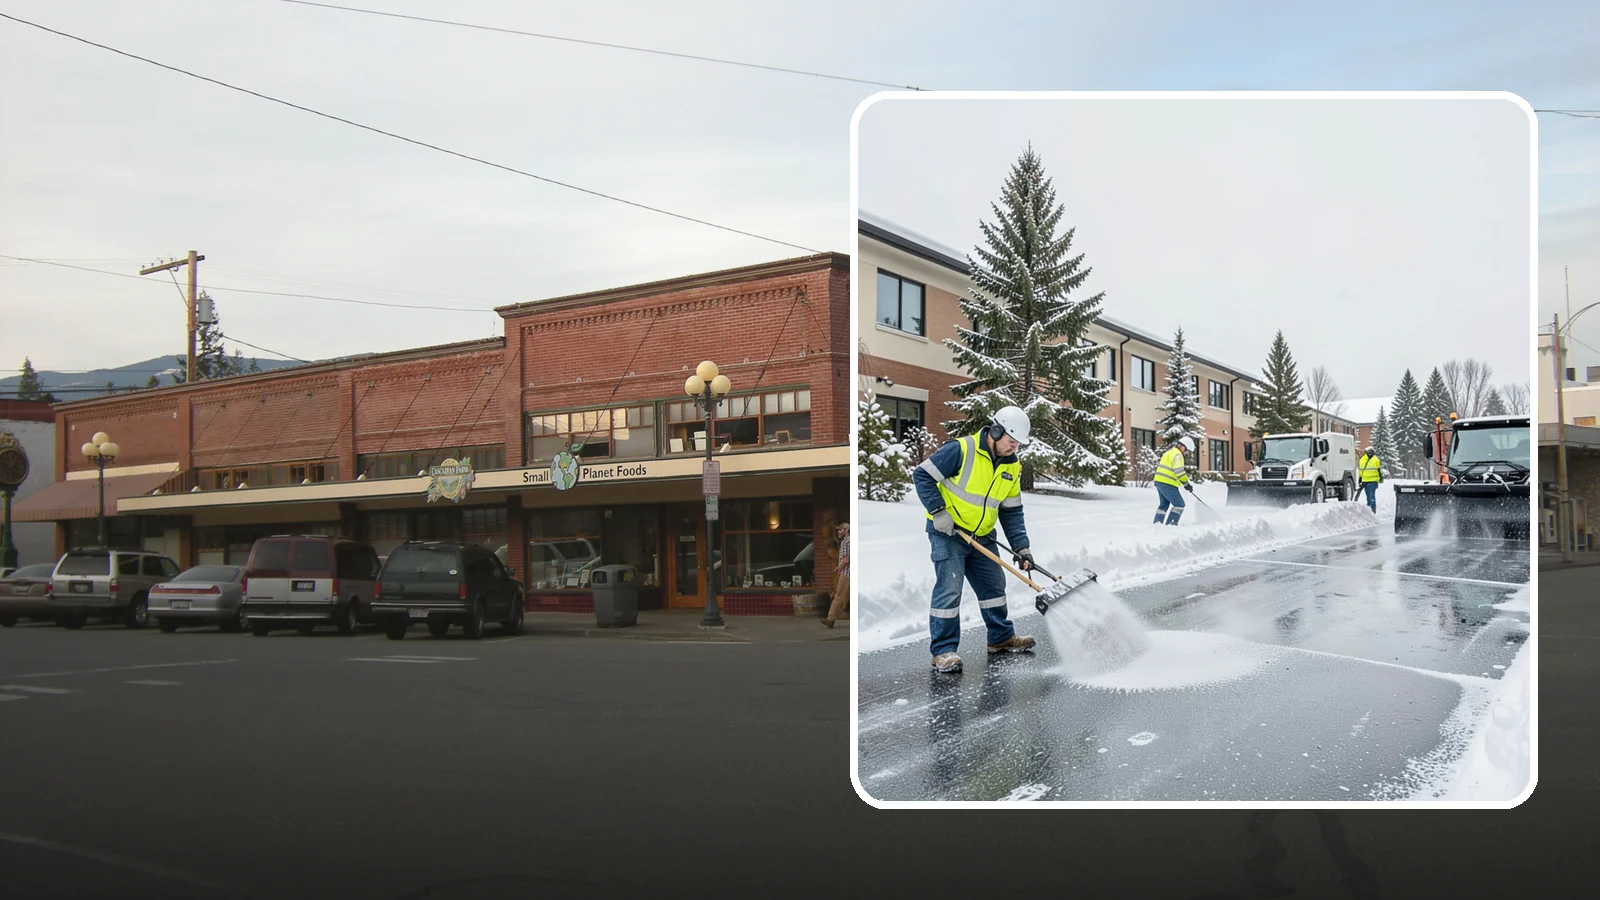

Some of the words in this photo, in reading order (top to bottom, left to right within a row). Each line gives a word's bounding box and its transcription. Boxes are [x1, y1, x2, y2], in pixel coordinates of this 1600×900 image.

[523, 471, 549, 482] Small
[583, 468, 614, 479] Planet
[617, 464, 647, 477] Foods
